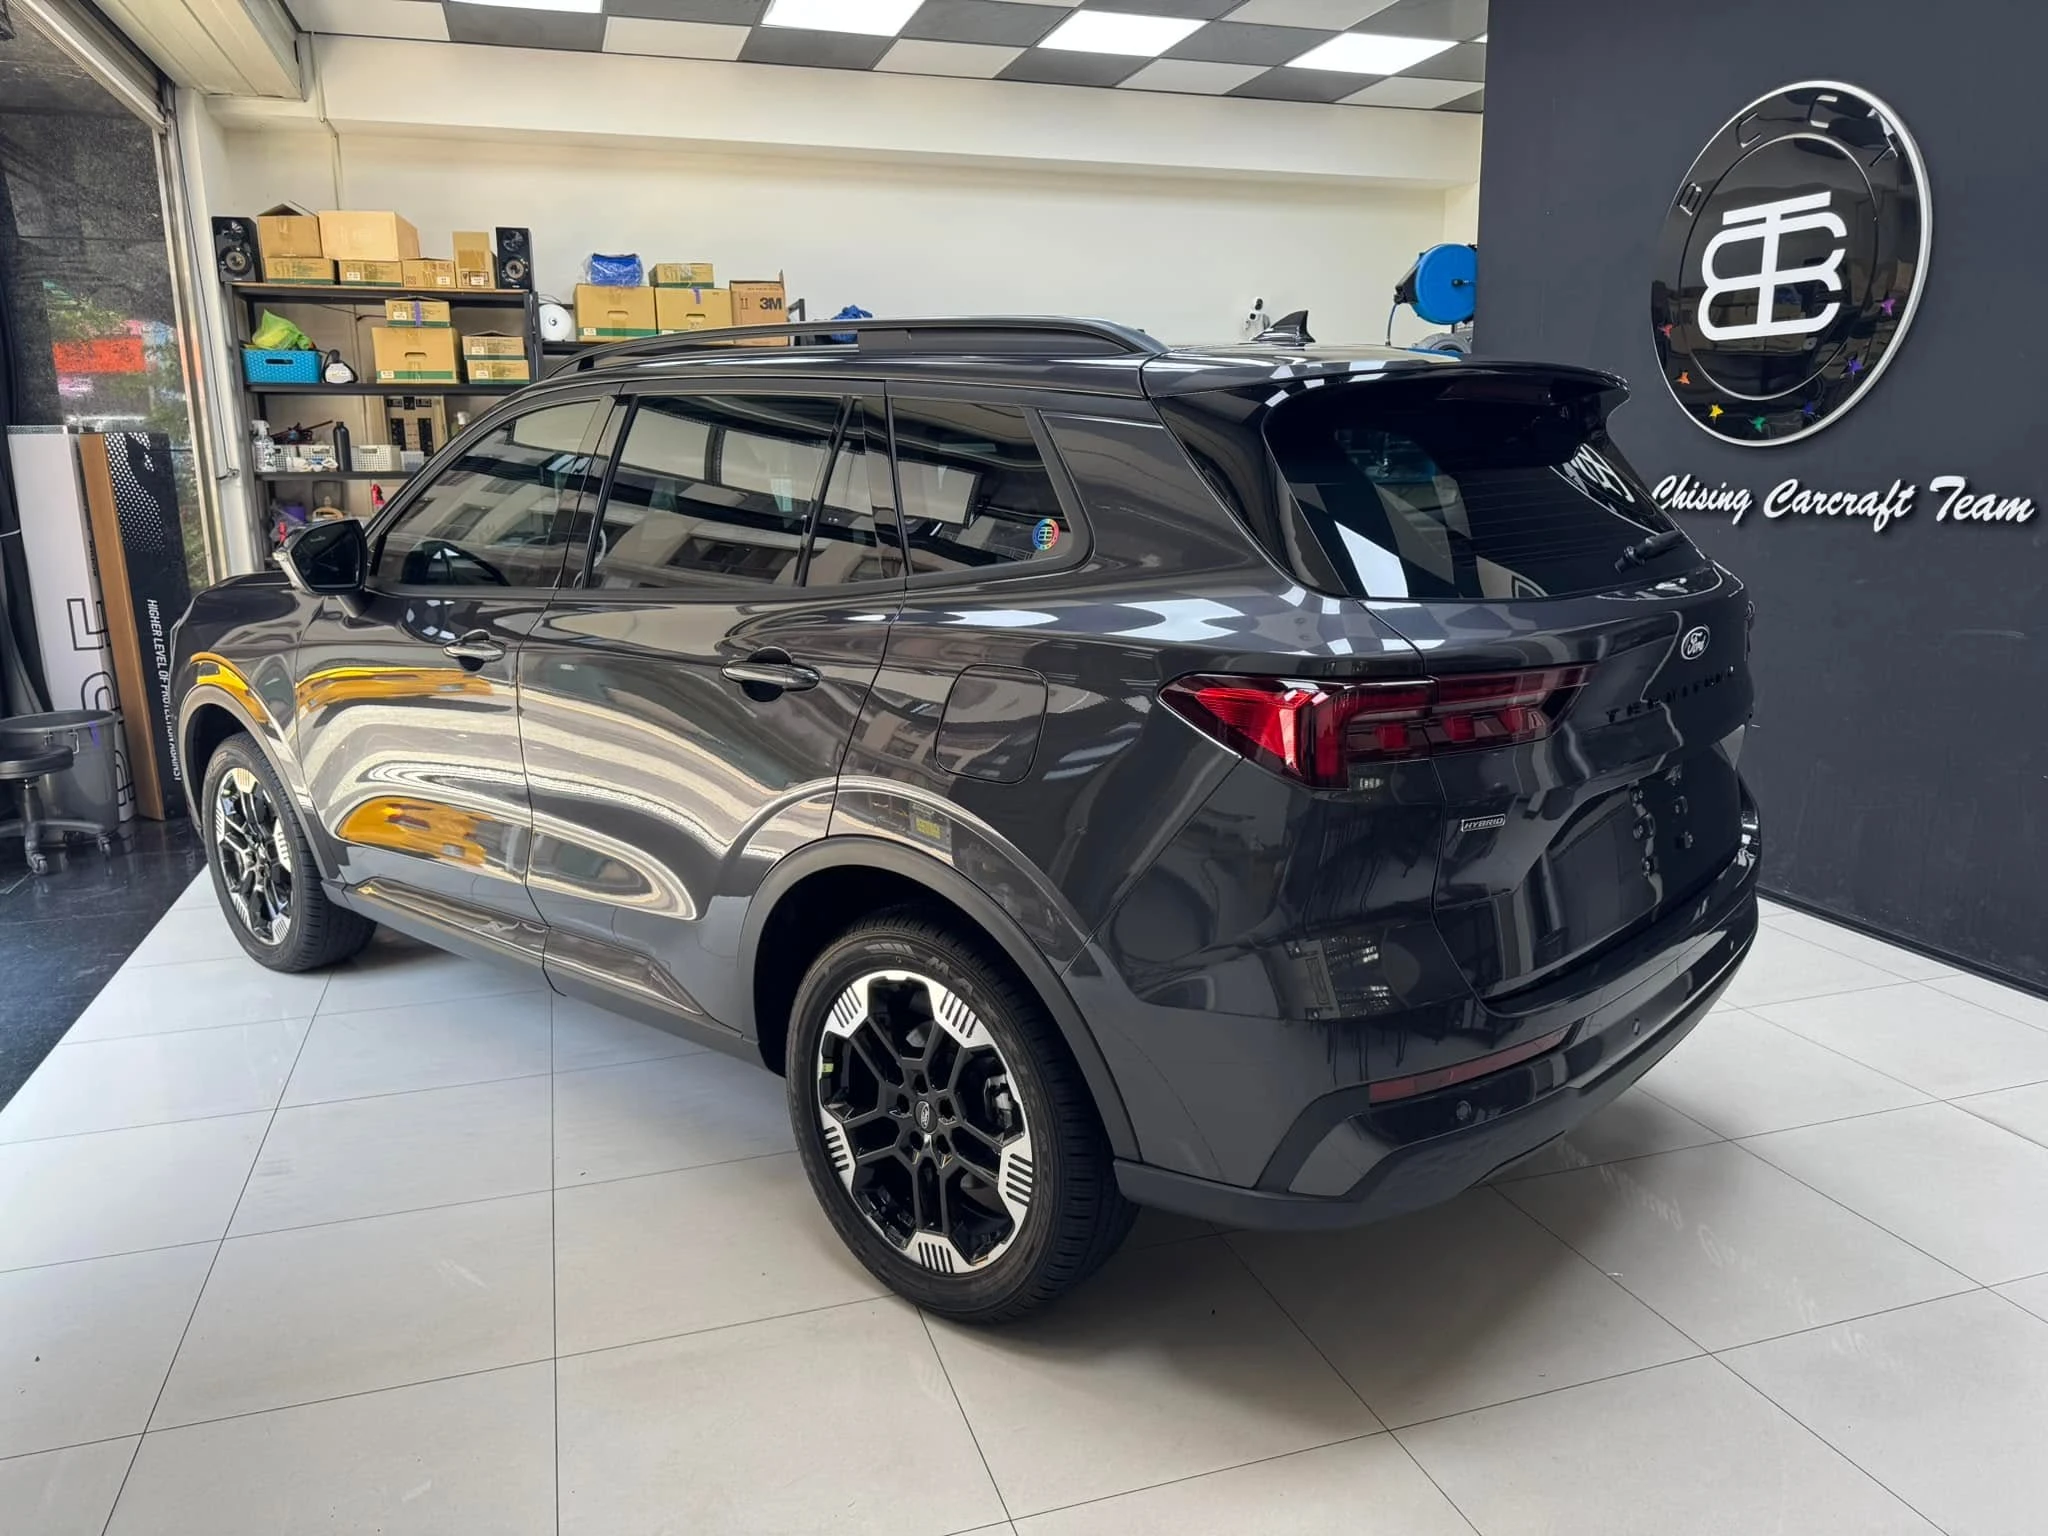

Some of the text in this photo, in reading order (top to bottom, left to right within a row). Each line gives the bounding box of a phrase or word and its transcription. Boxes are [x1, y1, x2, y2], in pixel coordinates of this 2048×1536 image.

[760, 297, 782, 310] 3M
[1651, 474, 2035, 533] Chising Carcraft Team
[147, 599, 162, 637] HIGHER
[153, 638, 168, 669] LEVEL
[1464, 817, 1504, 829] HYBRID
